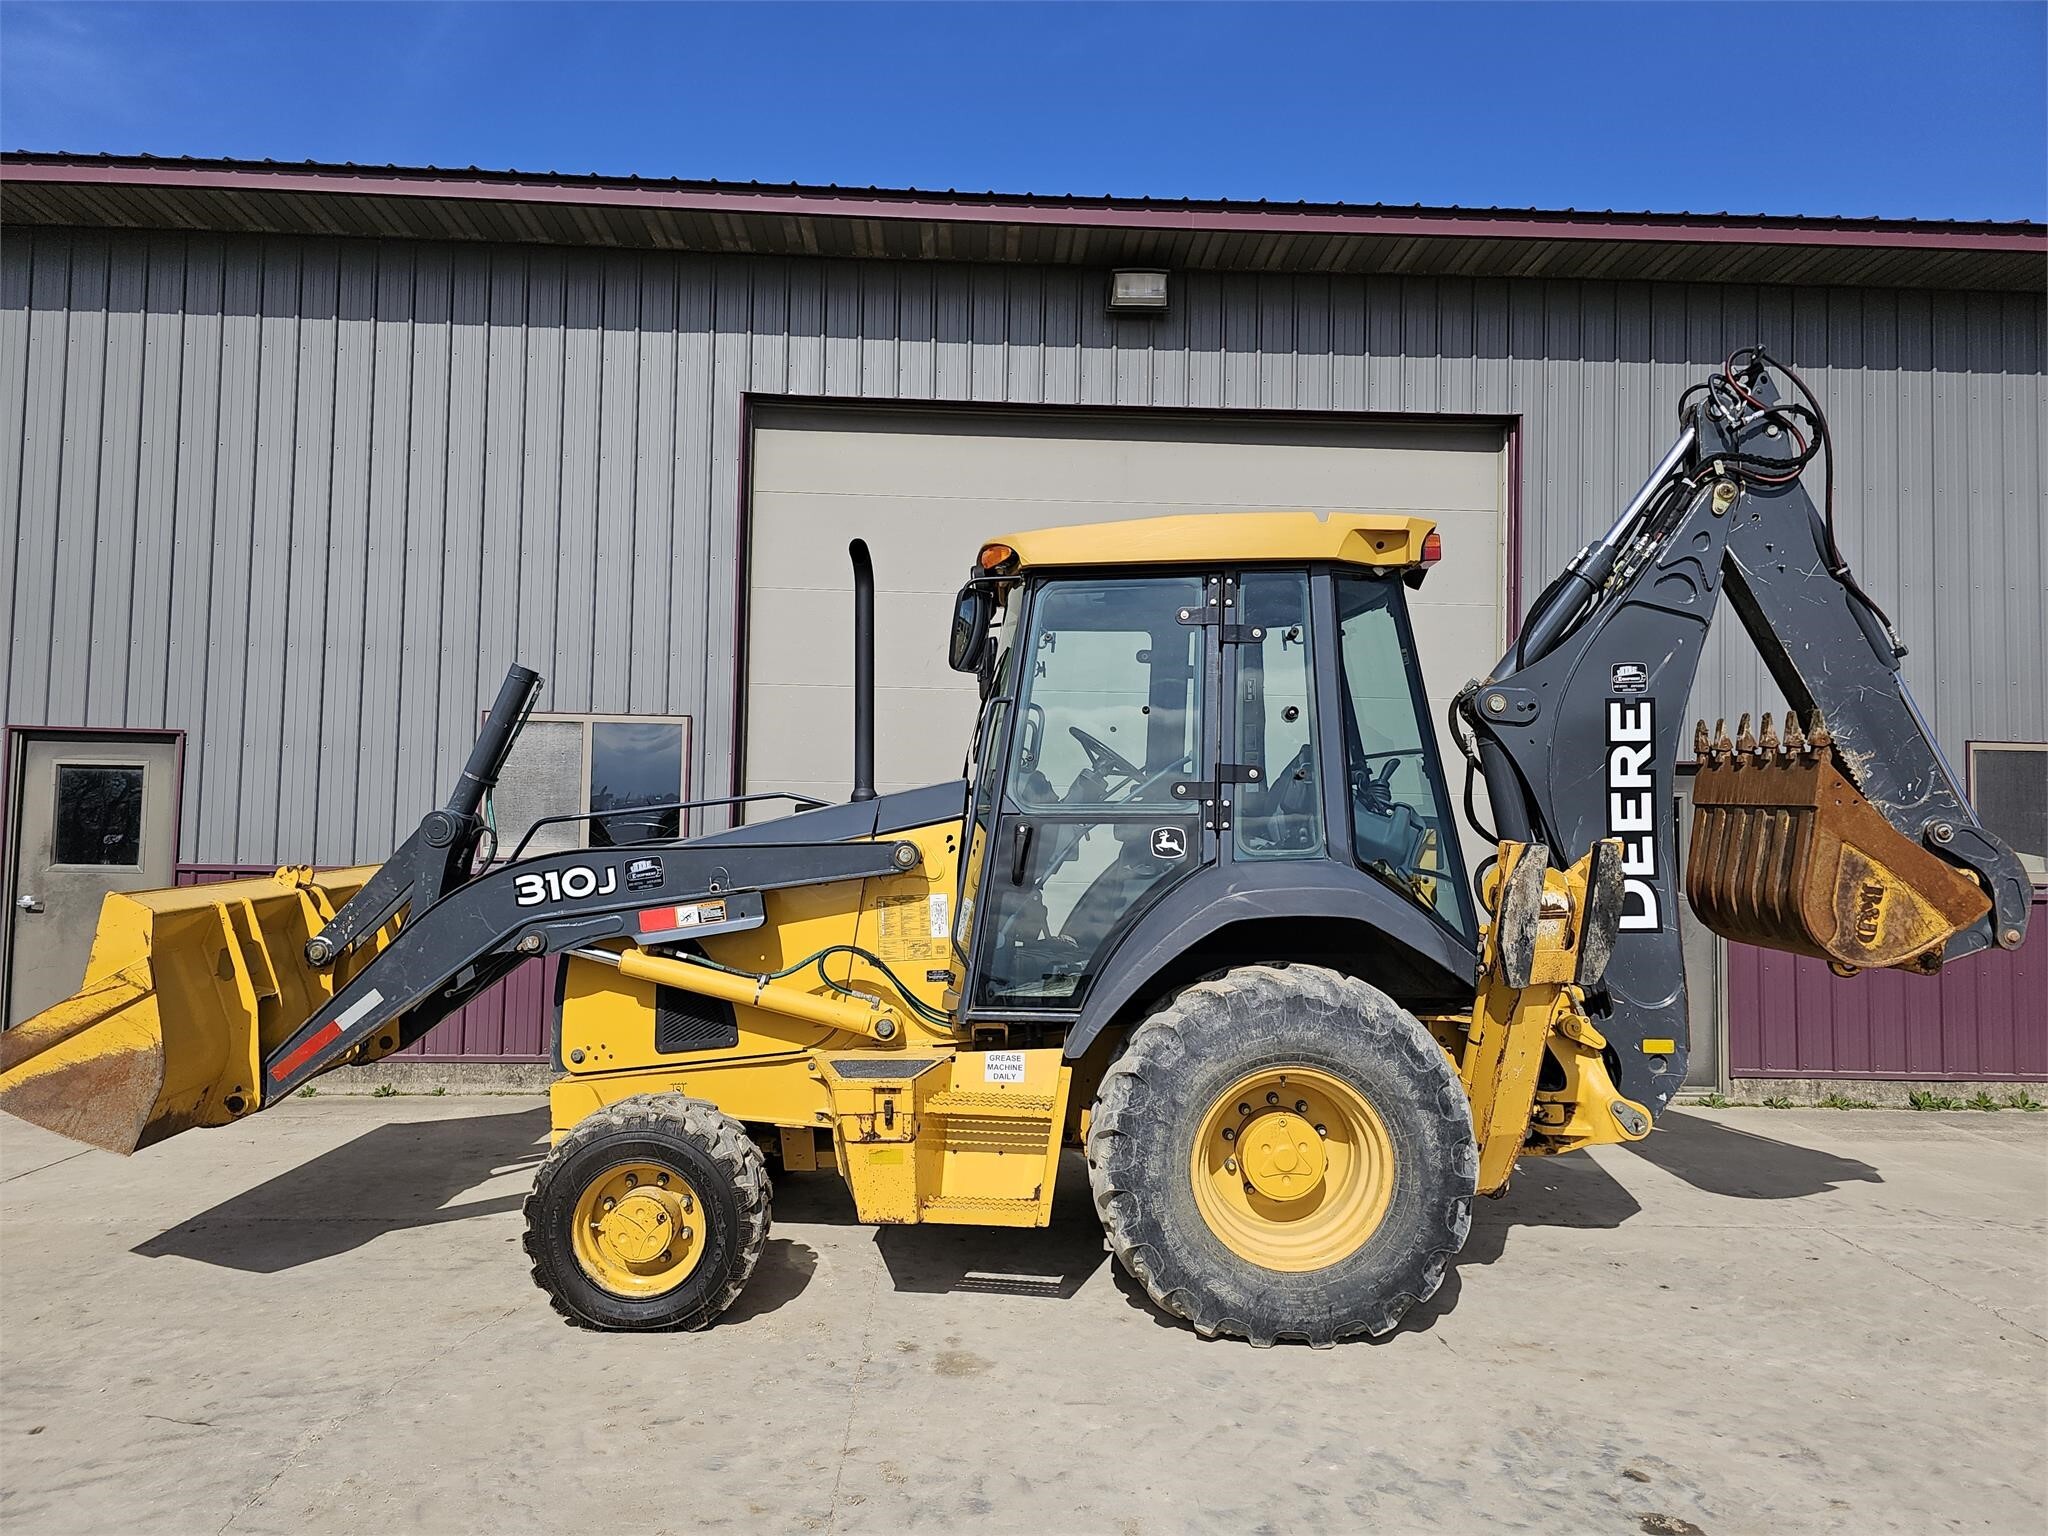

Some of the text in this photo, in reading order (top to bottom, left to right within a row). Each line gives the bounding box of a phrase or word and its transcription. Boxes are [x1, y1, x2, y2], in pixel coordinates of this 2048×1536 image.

[1609, 702, 1659, 929] DEERE
[515, 866, 617, 906] 310J
[989, 1054, 1022, 1062] GREASE
[987, 1063, 1023, 1071] MACHINE
[993, 1072, 1017, 1080] DAILY
